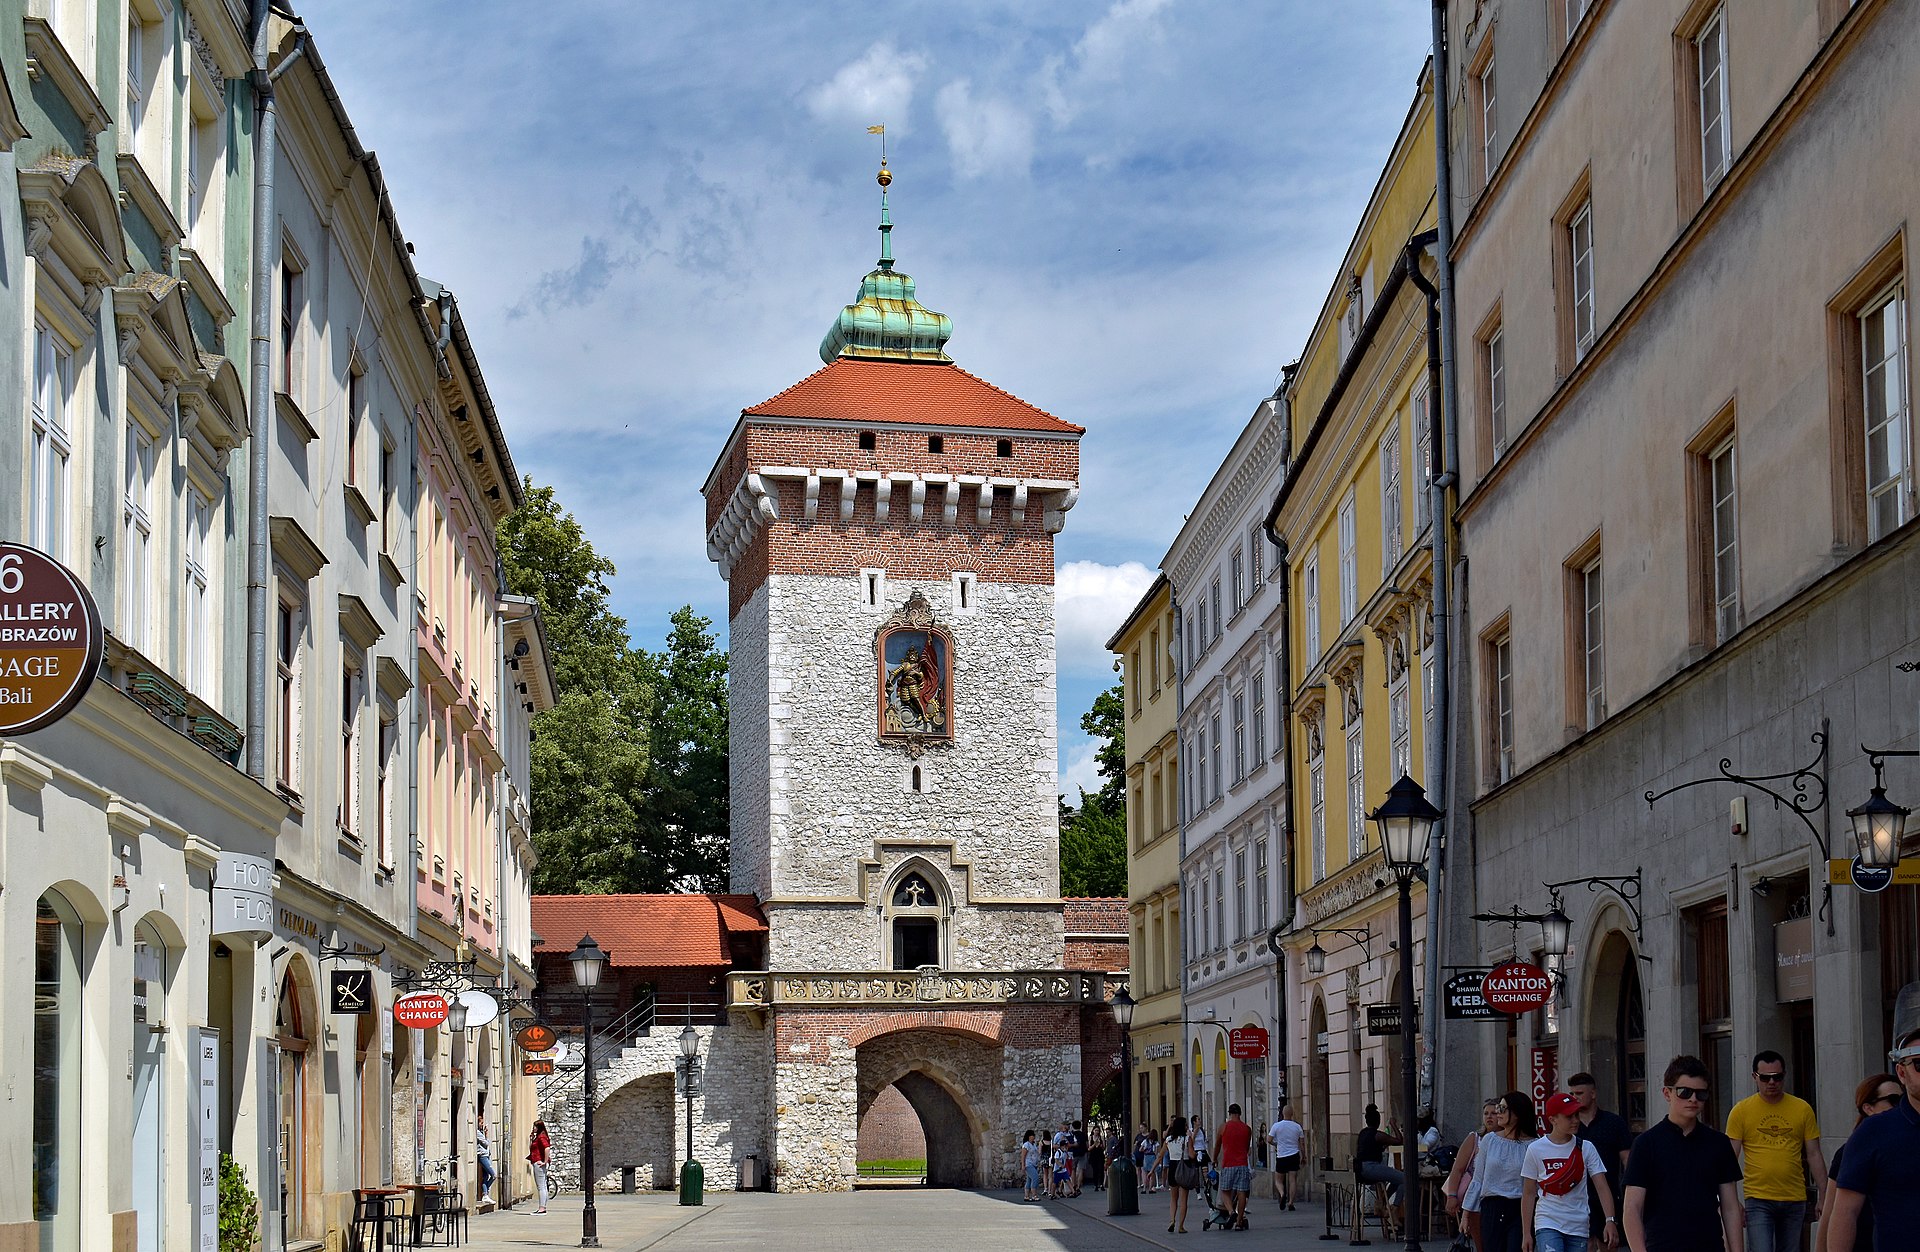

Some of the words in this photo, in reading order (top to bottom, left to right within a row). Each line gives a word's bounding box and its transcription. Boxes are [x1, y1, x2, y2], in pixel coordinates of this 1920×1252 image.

[0, 602, 74, 621] LLERY
[0, 625, 78, 642] BRAZÓW
[0, 656, 61, 677] AGE
[1488, 978, 1548, 991] KANTOR
[1492, 993, 1542, 1003] EXCHANGE
[399, 1000, 443, 1009] KANTOR
[399, 1011, 444, 1020] CHANGE
[525, 1063, 540, 1074] 24
[543, 1062, 551, 1073] h
